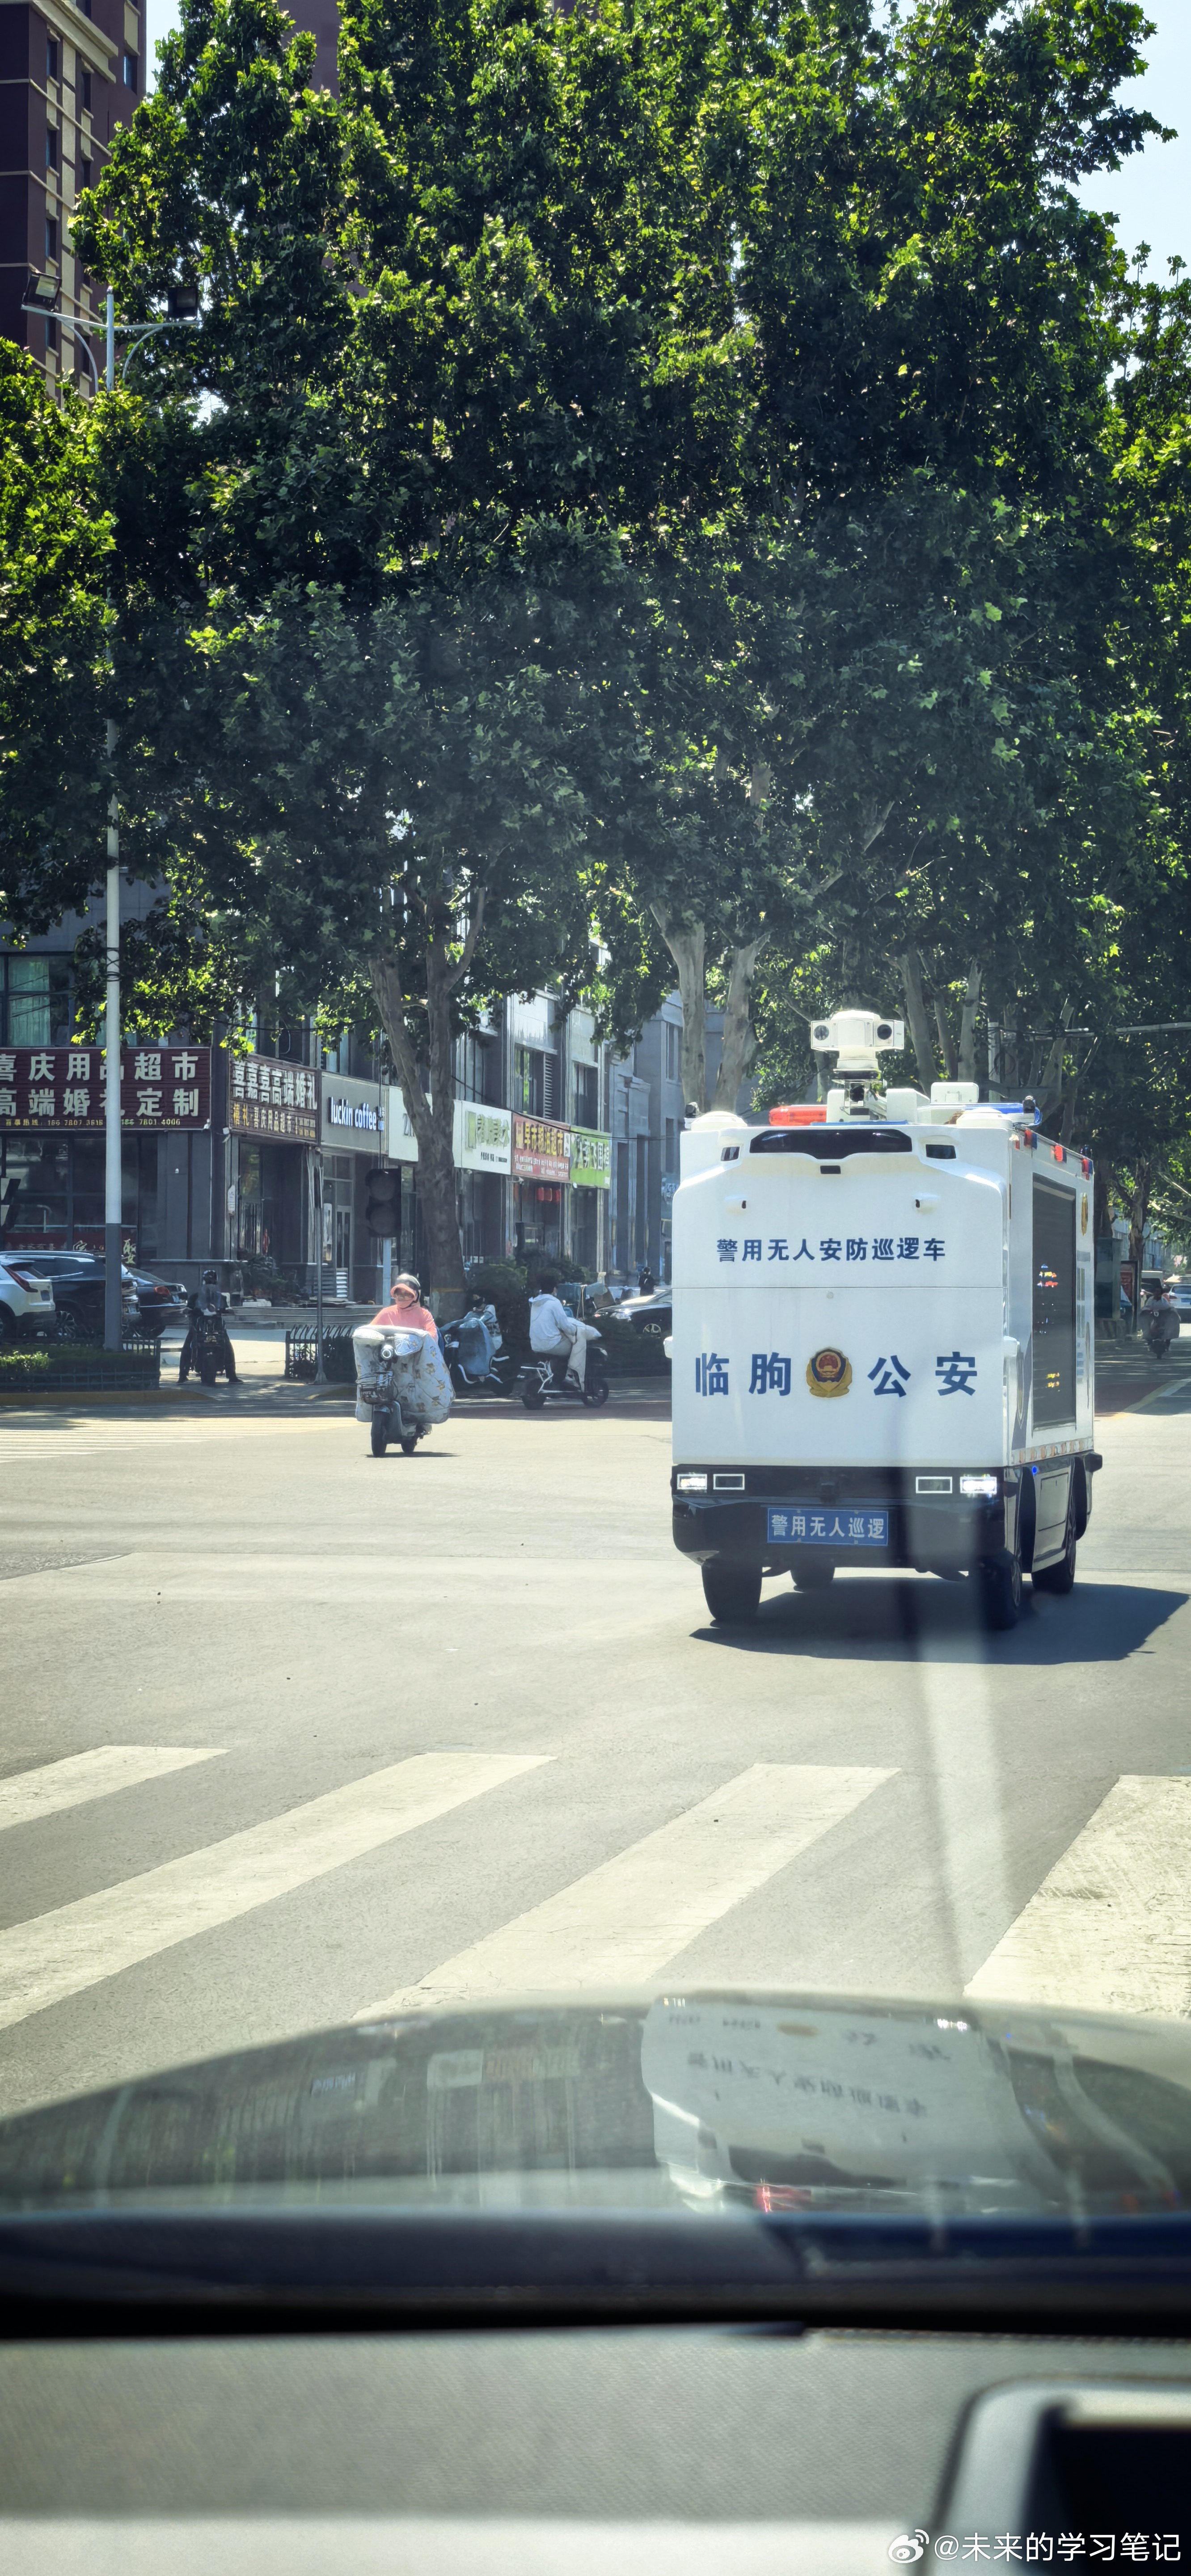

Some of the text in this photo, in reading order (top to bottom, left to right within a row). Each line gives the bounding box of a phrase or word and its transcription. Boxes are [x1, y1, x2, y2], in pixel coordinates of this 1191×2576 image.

[330, 1096, 353, 1127] luckin
[355, 1102, 376, 1131] coffee
[716, 1237, 946, 1263] 警用无人安防巡逻车
[695, 1352, 978, 1398] 临朐 公安
[771, 1514, 885, 1540] 警用无人巡逻
